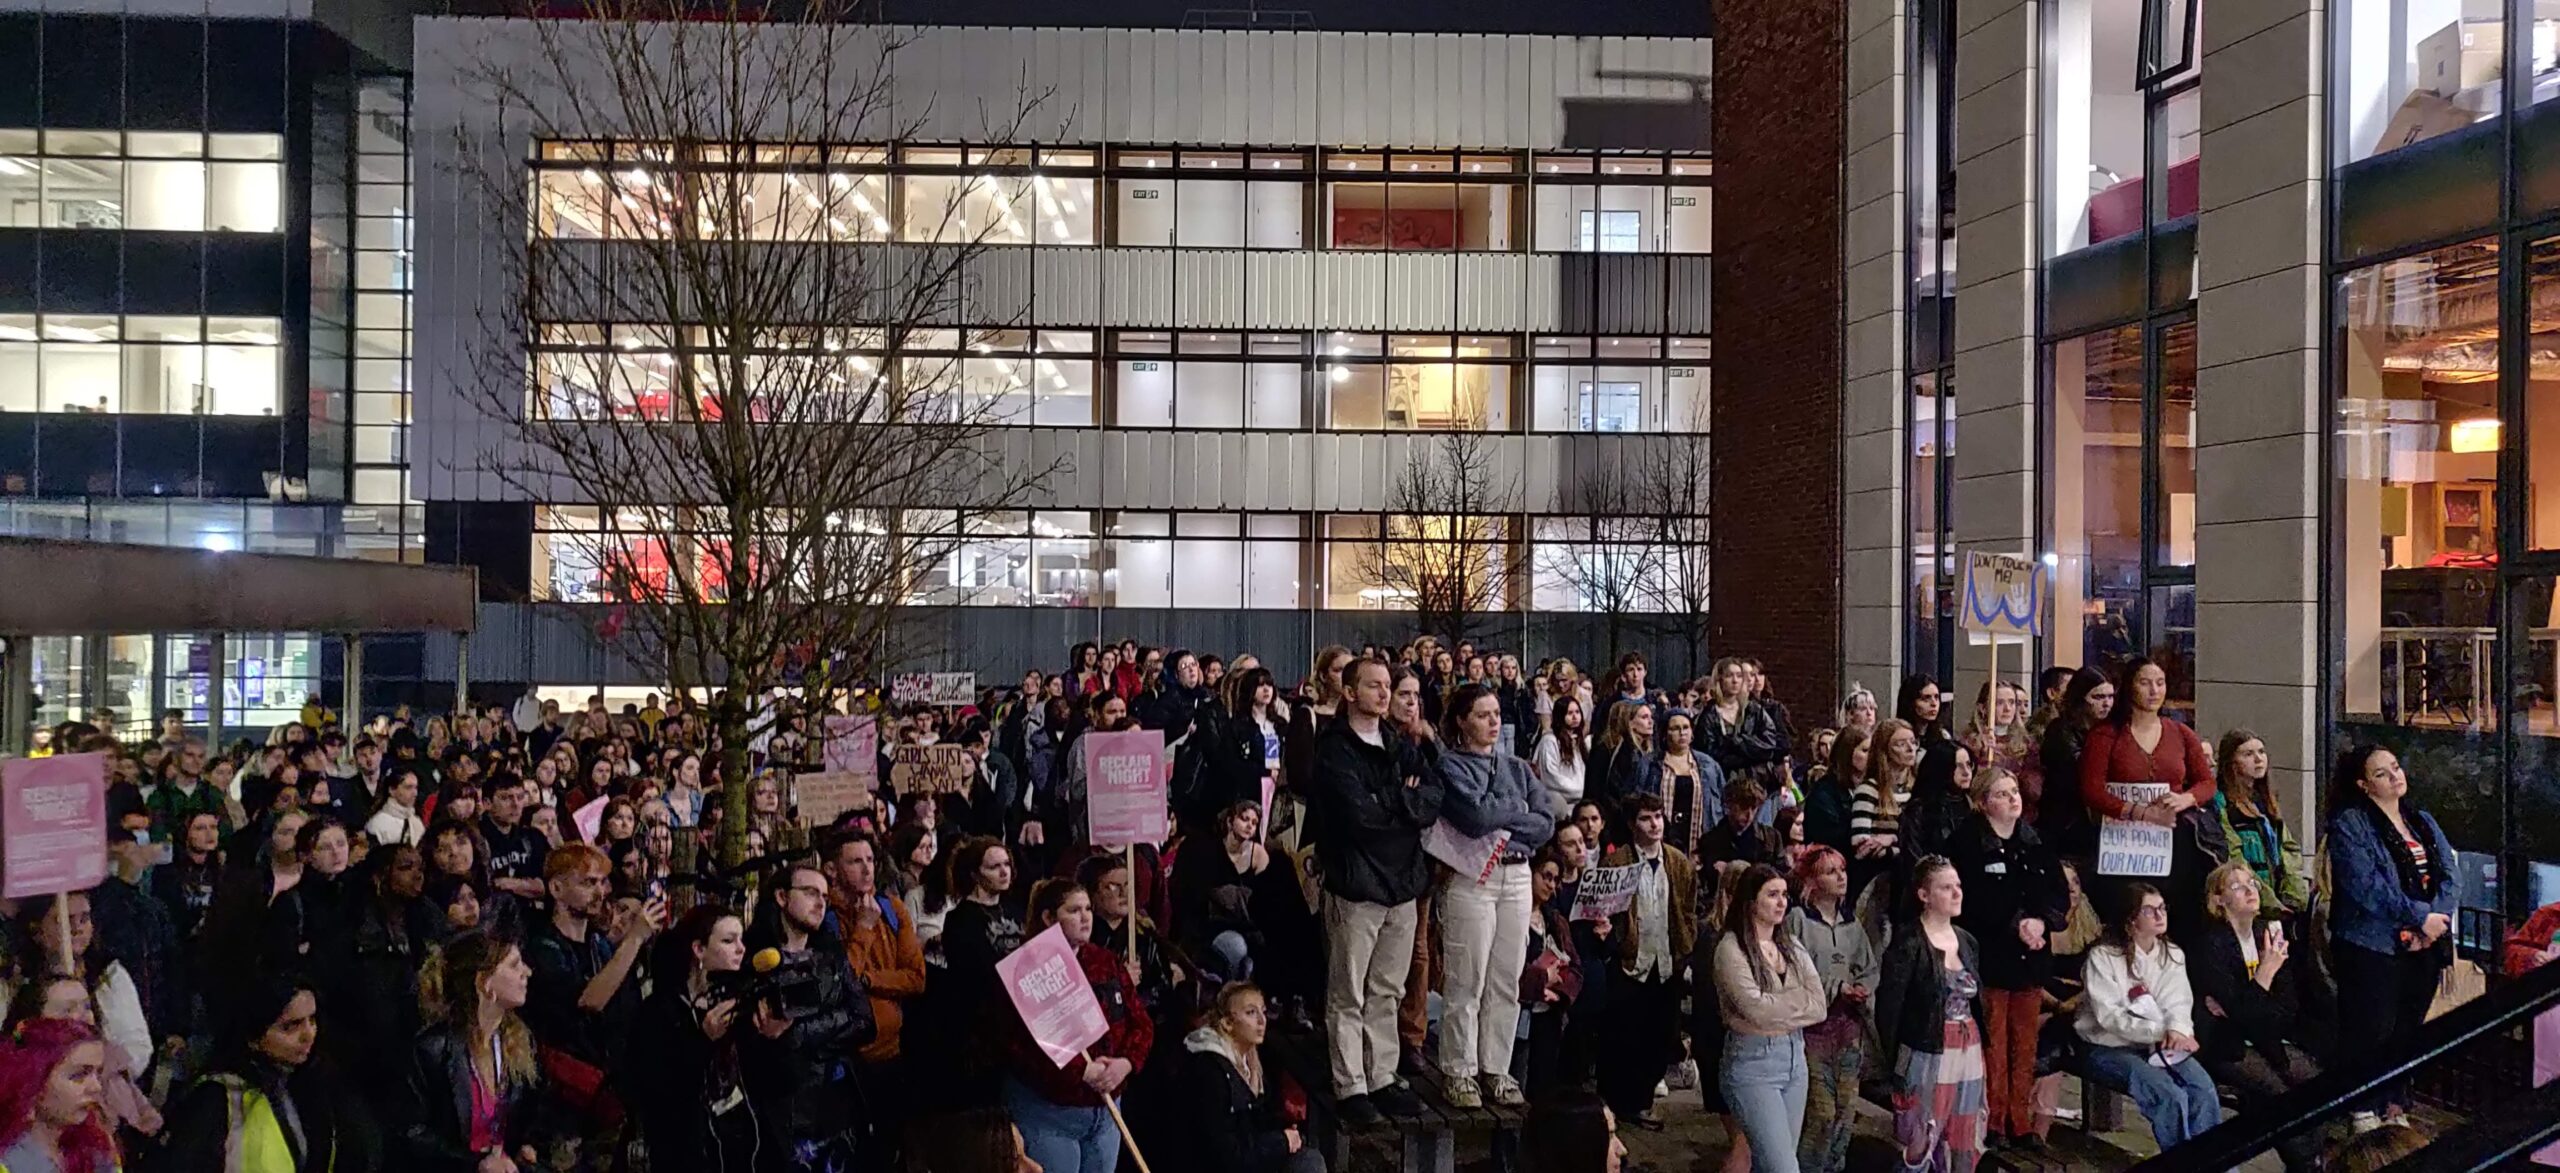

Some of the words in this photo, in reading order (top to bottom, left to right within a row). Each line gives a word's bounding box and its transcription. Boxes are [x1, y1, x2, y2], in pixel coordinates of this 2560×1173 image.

[2000, 556, 2033, 573] TOUCH
[935, 748, 962, 766] JUST
[1099, 754, 1151, 769] RECLAIM
[1108, 768, 1150, 785] NIGHT
[2103, 827, 2128, 847] OUR
[2131, 828, 2169, 848] POWER
[2101, 851, 2125, 872] OUR
[2126, 854, 2166, 873] NIGHT
[1583, 869, 1621, 884] GIRLS
[1580, 881, 1617, 894] WANNA
[1018, 953, 1066, 997] RECLAIM
[1031, 966, 1071, 1003] NIGHT
